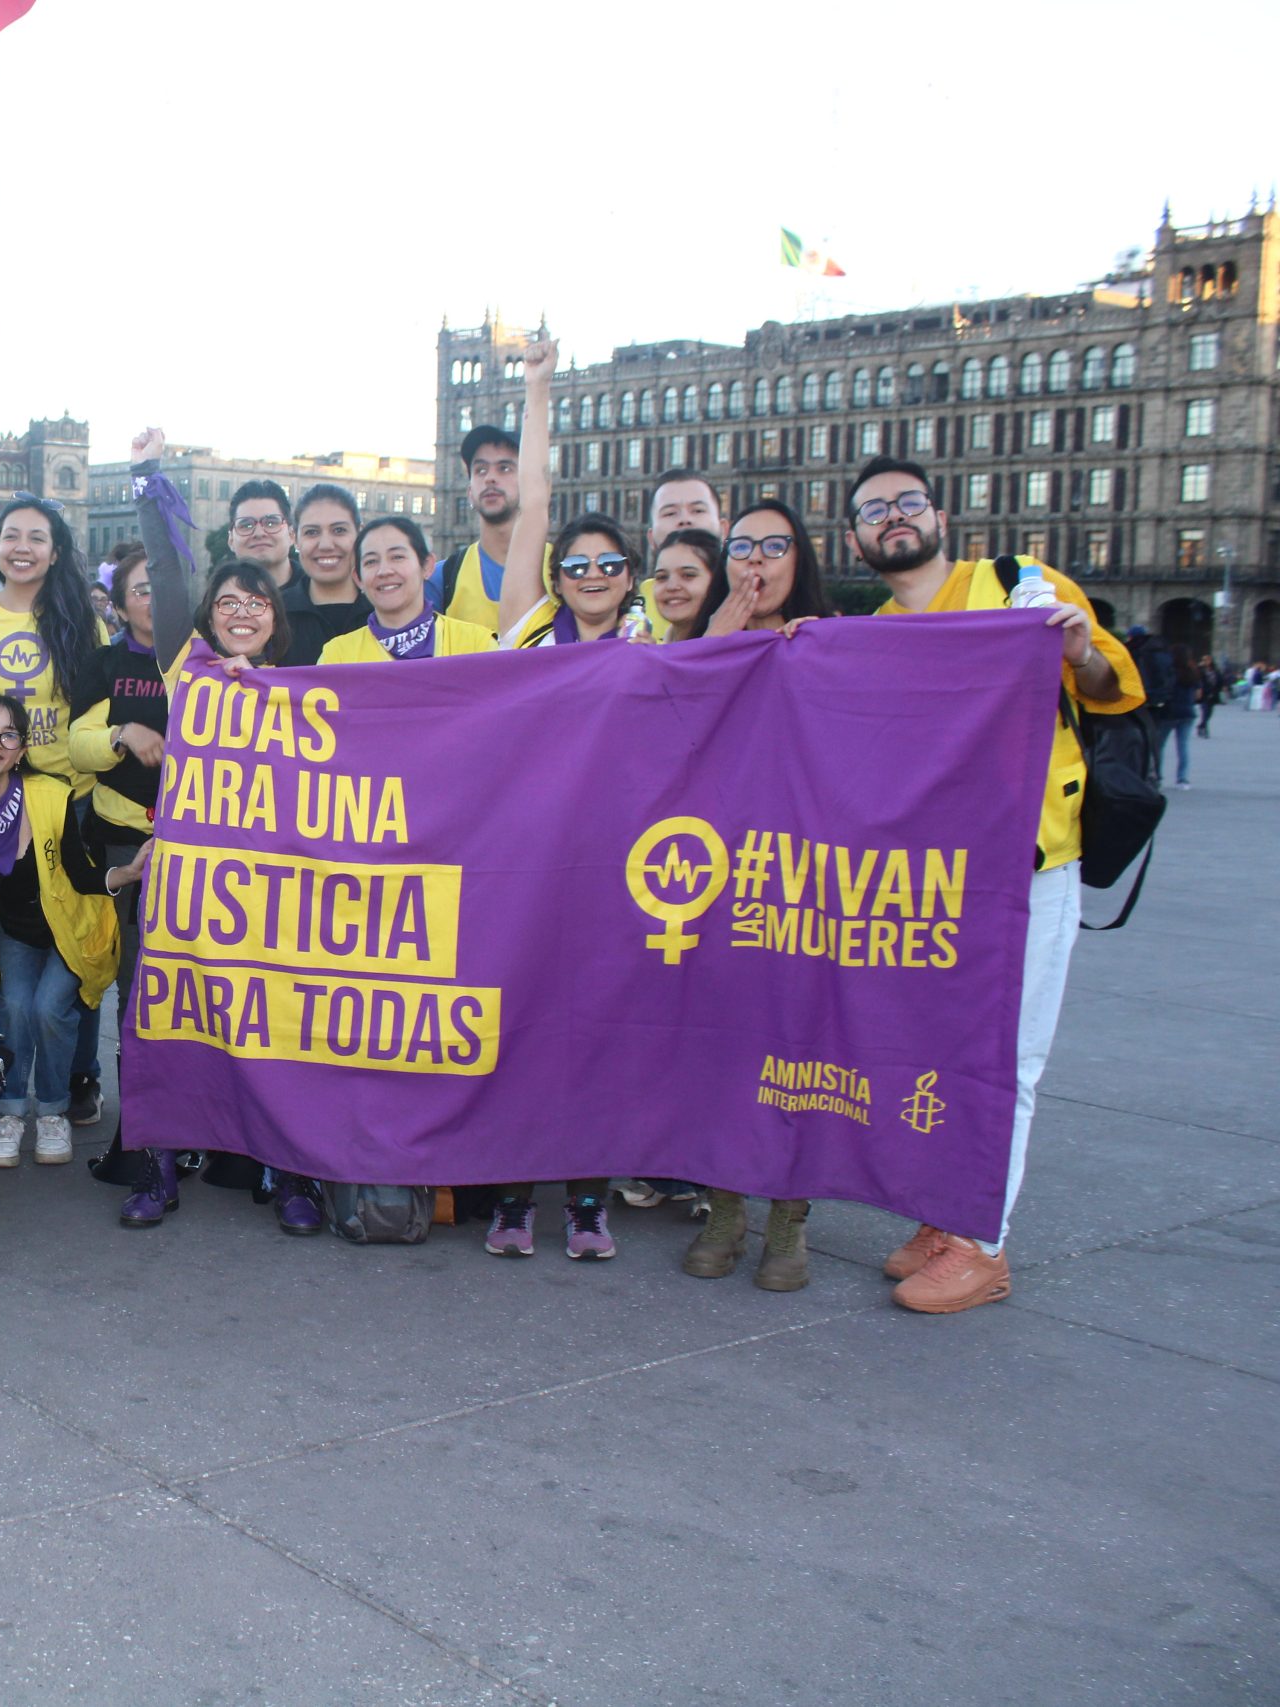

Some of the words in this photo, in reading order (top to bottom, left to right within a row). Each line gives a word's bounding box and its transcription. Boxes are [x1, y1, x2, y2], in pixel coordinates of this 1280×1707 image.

[160, 754, 277, 832] PARA
[295, 770, 409, 844] UNA
[146, 853, 431, 961] JUSTICIA
[733, 829, 968, 919] #VIVAN
[731, 901, 765, 948] LAS
[765, 904, 960, 968] MUJERES
[139, 964, 271, 1048] PARA
[293, 982, 483, 1066] TODAS
[758, 1086, 871, 1125] INTERNACIONAL
[760, 1055, 871, 1104] AMNISTÍA
